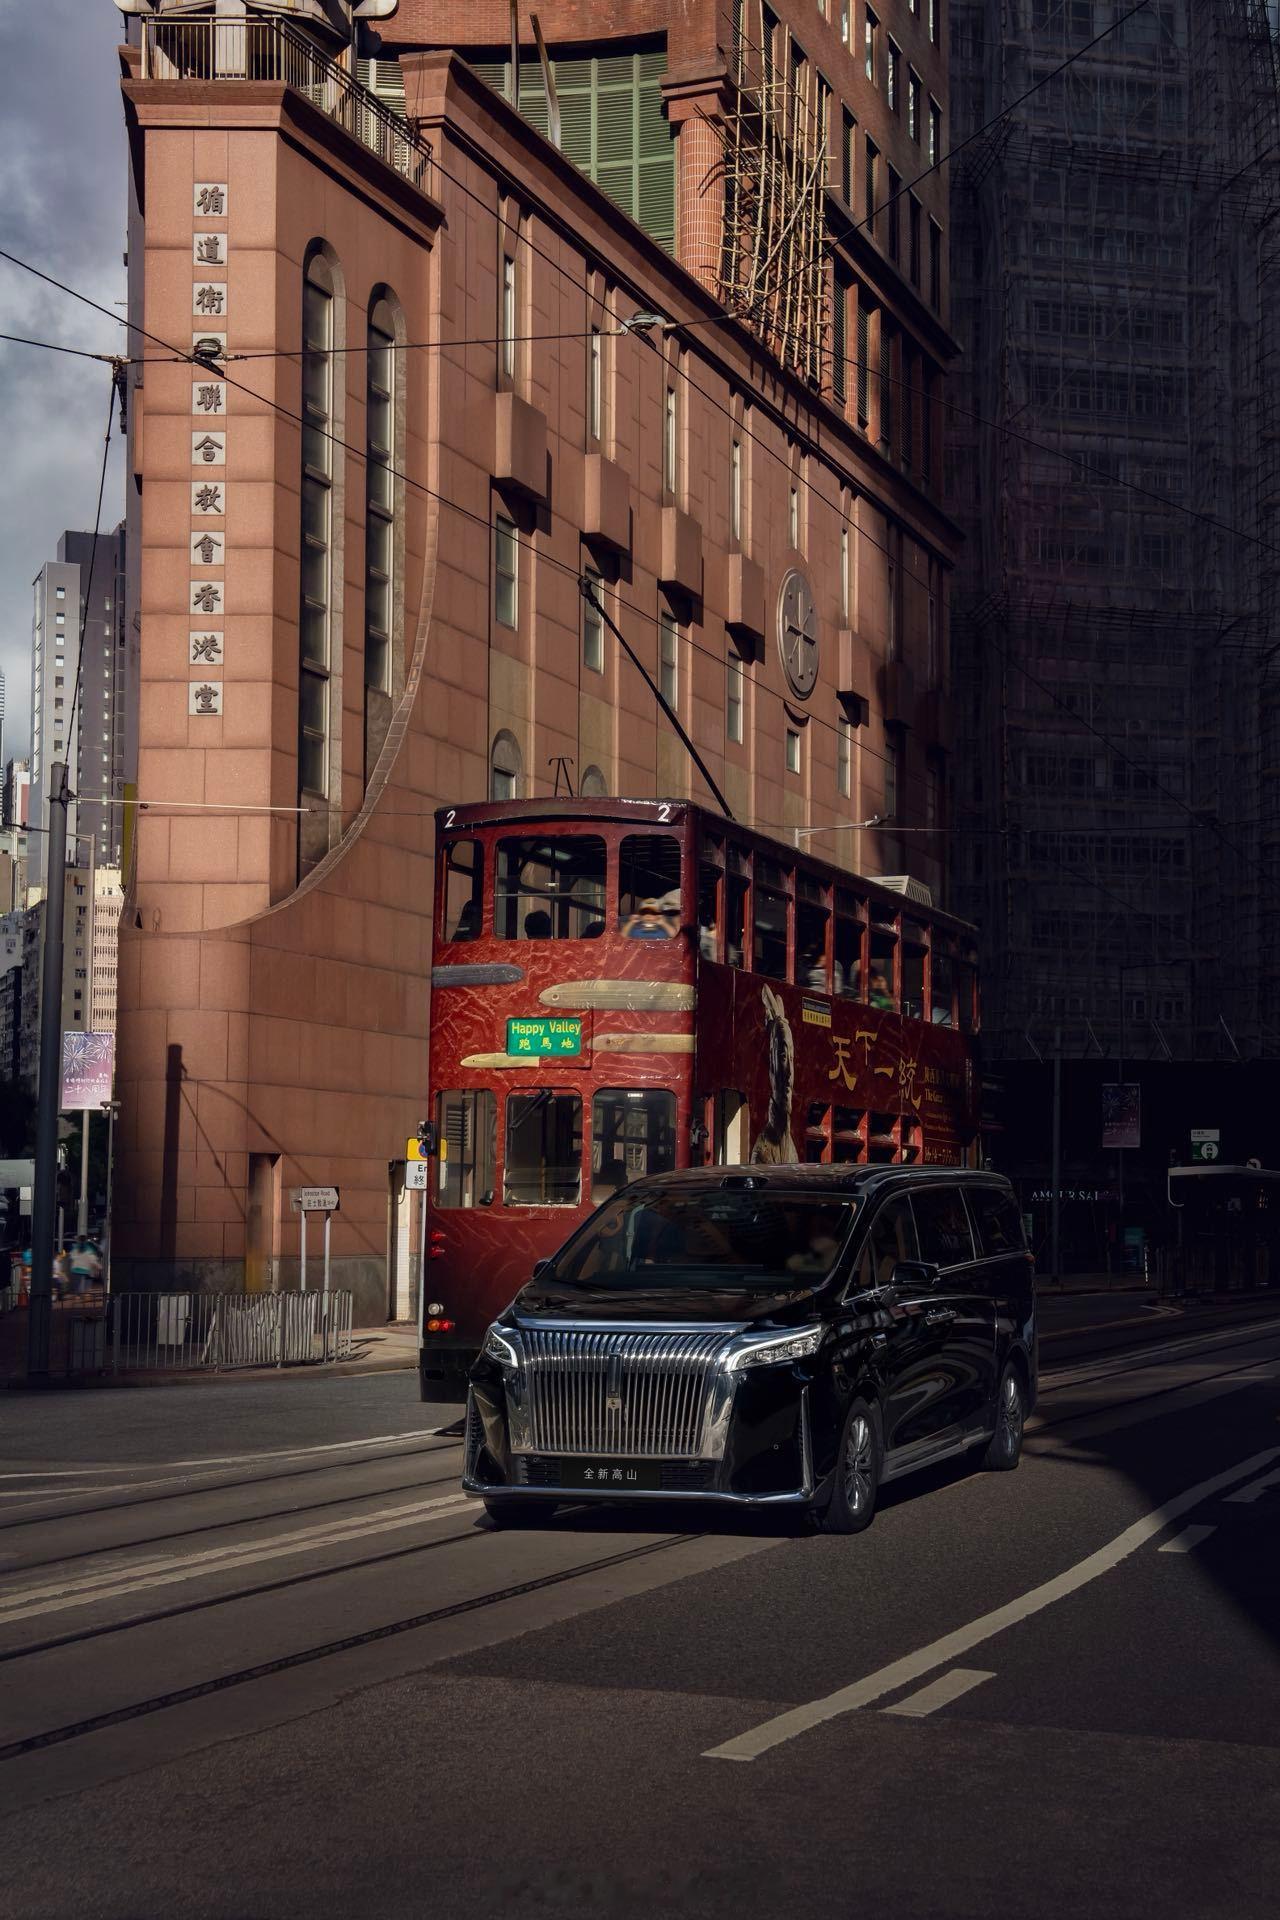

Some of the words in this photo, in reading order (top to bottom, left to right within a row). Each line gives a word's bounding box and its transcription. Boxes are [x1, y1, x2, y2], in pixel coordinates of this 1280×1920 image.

[192, 186, 226, 713] 循道衛聯合教會香港堂
[445, 810, 457, 828] 2
[657, 805, 671, 822] 2
[511, 1021, 545, 1036] Happy
[549, 1020, 581, 1036] Valley
[518, 1037, 575, 1050] 跑馬地
[583, 1467, 637, 1481] 全新高山
